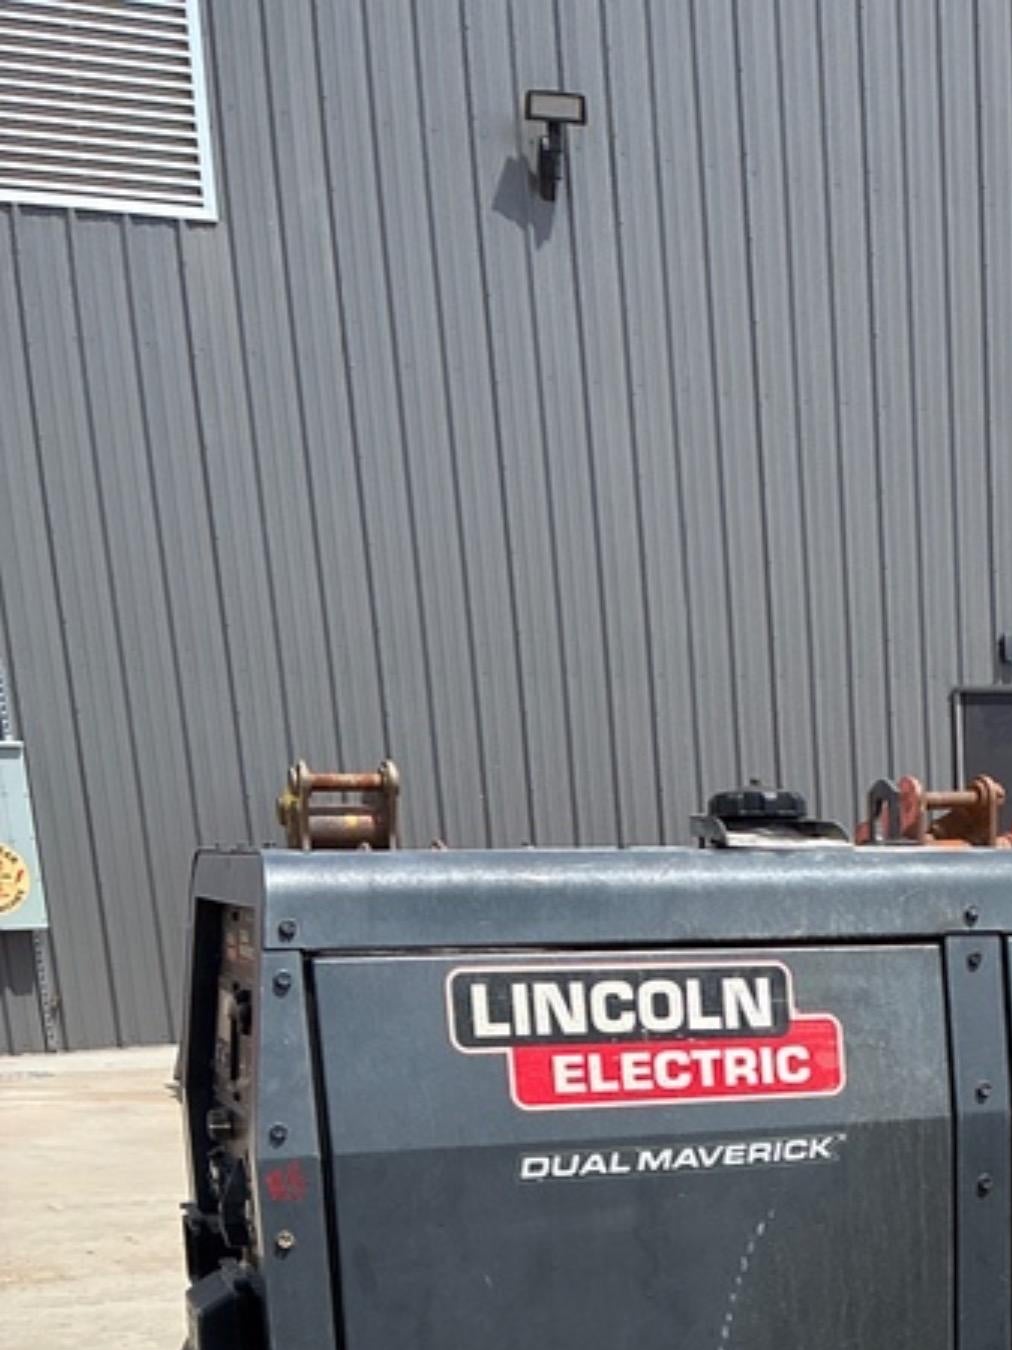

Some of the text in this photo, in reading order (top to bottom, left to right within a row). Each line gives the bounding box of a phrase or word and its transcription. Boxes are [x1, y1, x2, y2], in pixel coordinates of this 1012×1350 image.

[471, 977, 773, 1038] LINCOLN
[552, 1045, 812, 1095] ELECTRIC
[519, 1153, 632, 1182] DUAL
